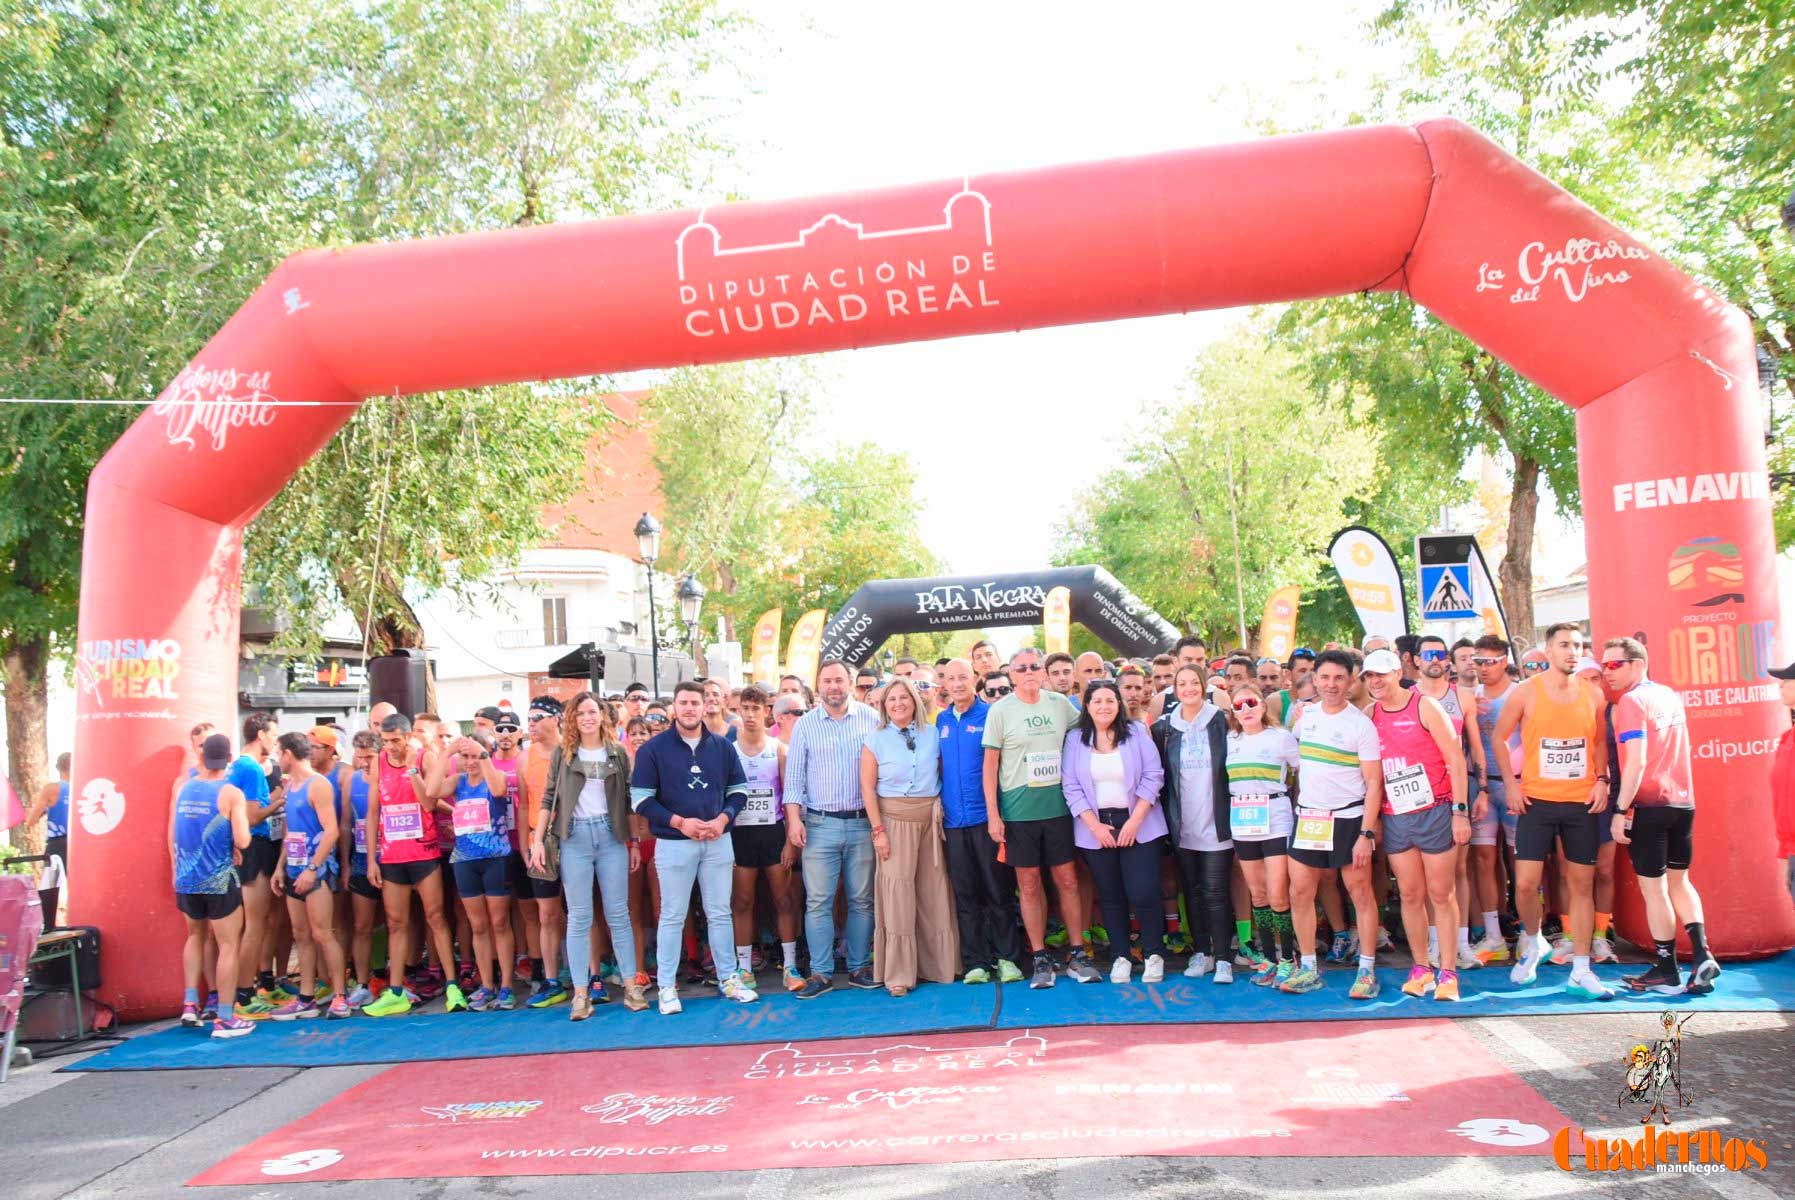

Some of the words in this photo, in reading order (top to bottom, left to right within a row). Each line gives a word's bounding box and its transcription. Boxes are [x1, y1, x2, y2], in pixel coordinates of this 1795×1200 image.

[952, 252, 996, 276] DE
[1476, 262, 1505, 292] La
[1518, 238, 1649, 285] Cultura
[1510, 285, 1540, 304] del
[1554, 264, 1632, 302] Vino
[685, 294, 868, 337] CIUDAD
[886, 279, 1000, 317] REAL
[915, 585, 970, 613] PATA
[828, 607, 857, 637] VINO
[846, 613, 873, 642] NOS
[941, 615, 973, 624] MARCA
[974, 612, 992, 621] MÁS
[994, 610, 1039, 620] PREMIADA
[1093, 591, 1158, 644] DENOMINACIONES
[1100, 608, 1112, 619] DE
[1111, 617, 1140, 641] ORIGEN
[1683, 612, 1737, 624] PROYECTO
[847, 637, 873, 662] UNE
[112, 677, 179, 699] REAL
[1705, 688, 1723, 706] DE
[1546, 752, 1581, 764] 5304
[1033, 765, 1058, 777] 0001
[1393, 781, 1420, 797] 5110
[390, 816, 414, 827] 1132
[463, 810, 477, 820] 44
[1007, 1050, 1046, 1058] DE
[744, 1062, 920, 1079] CIUDAD
[939, 1057, 1043, 1070] REAL
[481, 1144, 729, 1160] www.dipucr.es
